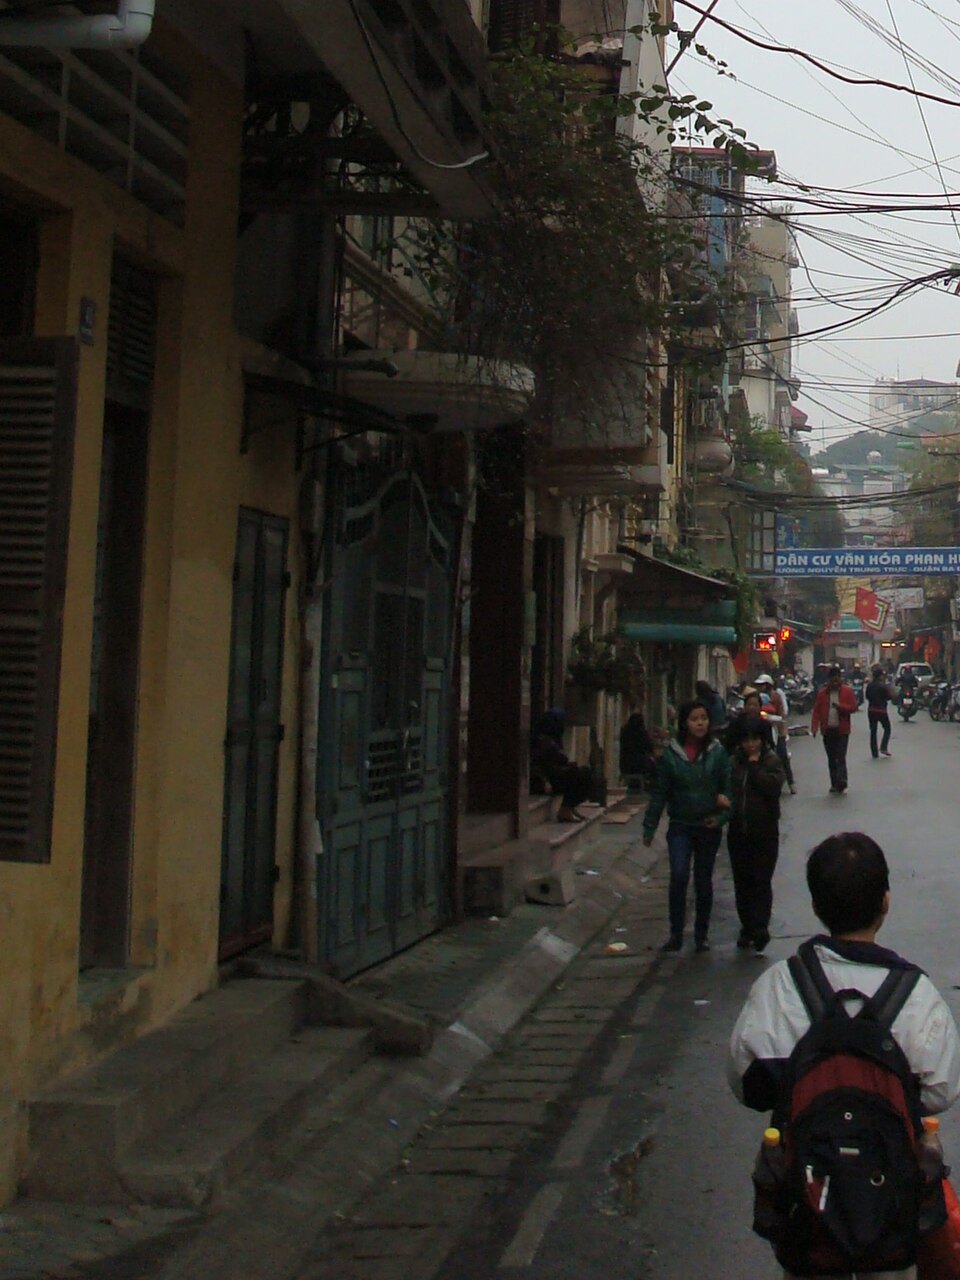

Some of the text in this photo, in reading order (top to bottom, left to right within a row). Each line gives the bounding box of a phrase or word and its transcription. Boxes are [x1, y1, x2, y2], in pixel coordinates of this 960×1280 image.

[777, 554, 808, 566] DÂN
[812, 555, 832, 566] CƯ
[835, 553, 865, 566] VĂN
[869, 551, 901, 565] HÓA
[905, 554, 944, 565] PHAN
[849, 566, 881, 574] TRUNG
